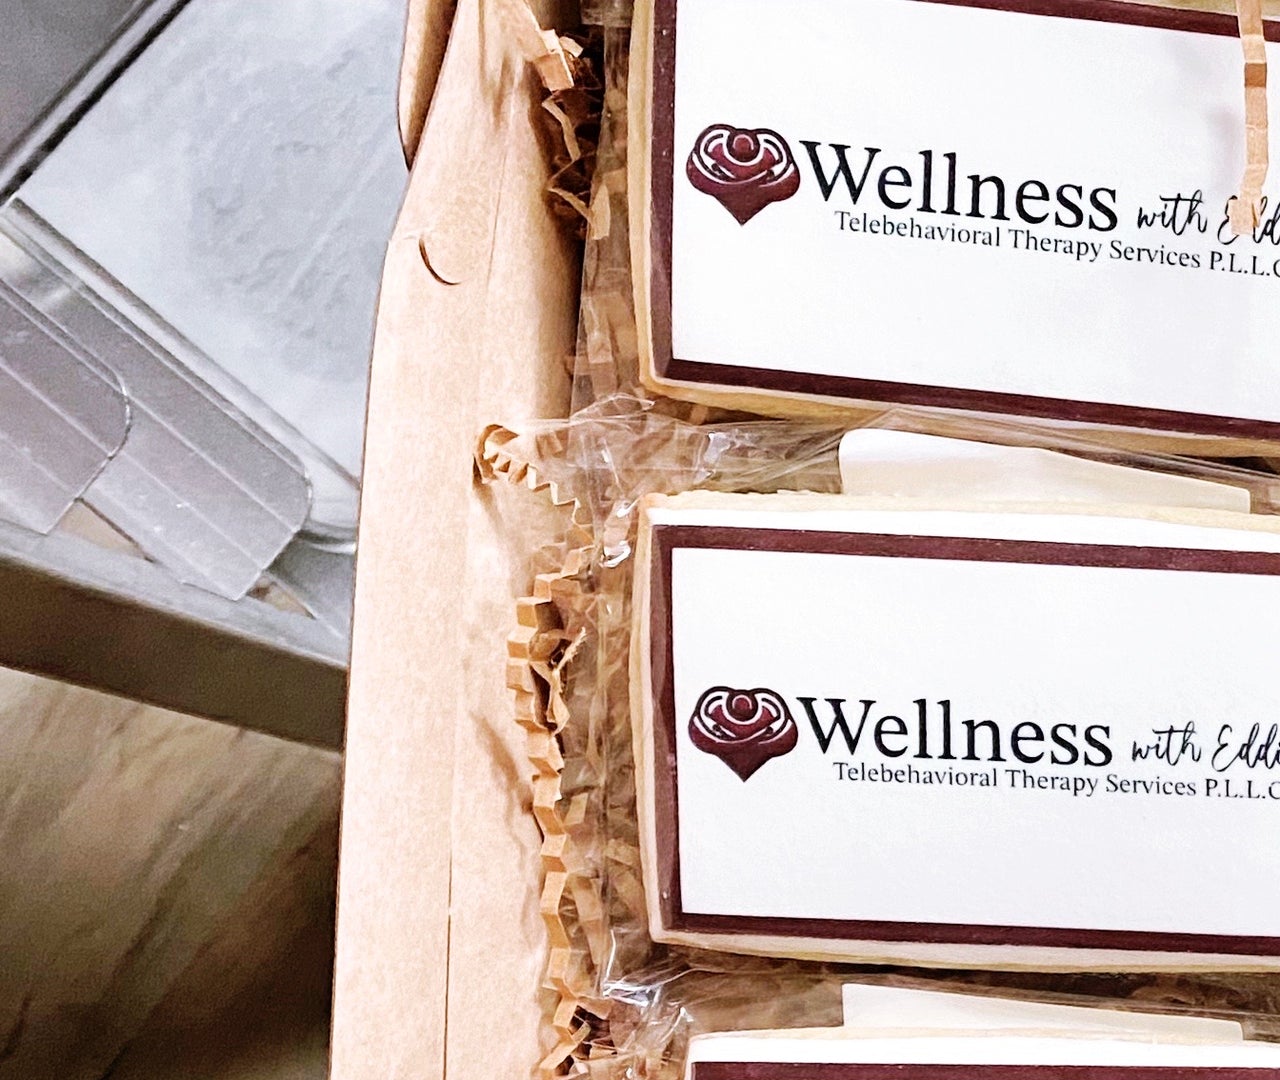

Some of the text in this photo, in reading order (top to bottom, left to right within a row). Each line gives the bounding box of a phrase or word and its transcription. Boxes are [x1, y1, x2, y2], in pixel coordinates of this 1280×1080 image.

[799, 140, 1118, 232] Wellness
[1137, 189, 1207, 236] with
[835, 211, 999, 246] Telebehavioral
[1008, 229, 1102, 262] Therapy
[1110, 240, 1200, 268] Services
[796, 697, 1112, 767] Wellness
[1132, 721, 1201, 766] with
[833, 762, 997, 786] Telebehavioral
[1005, 769, 1098, 797] Therapy
[1106, 774, 1196, 795] Services
